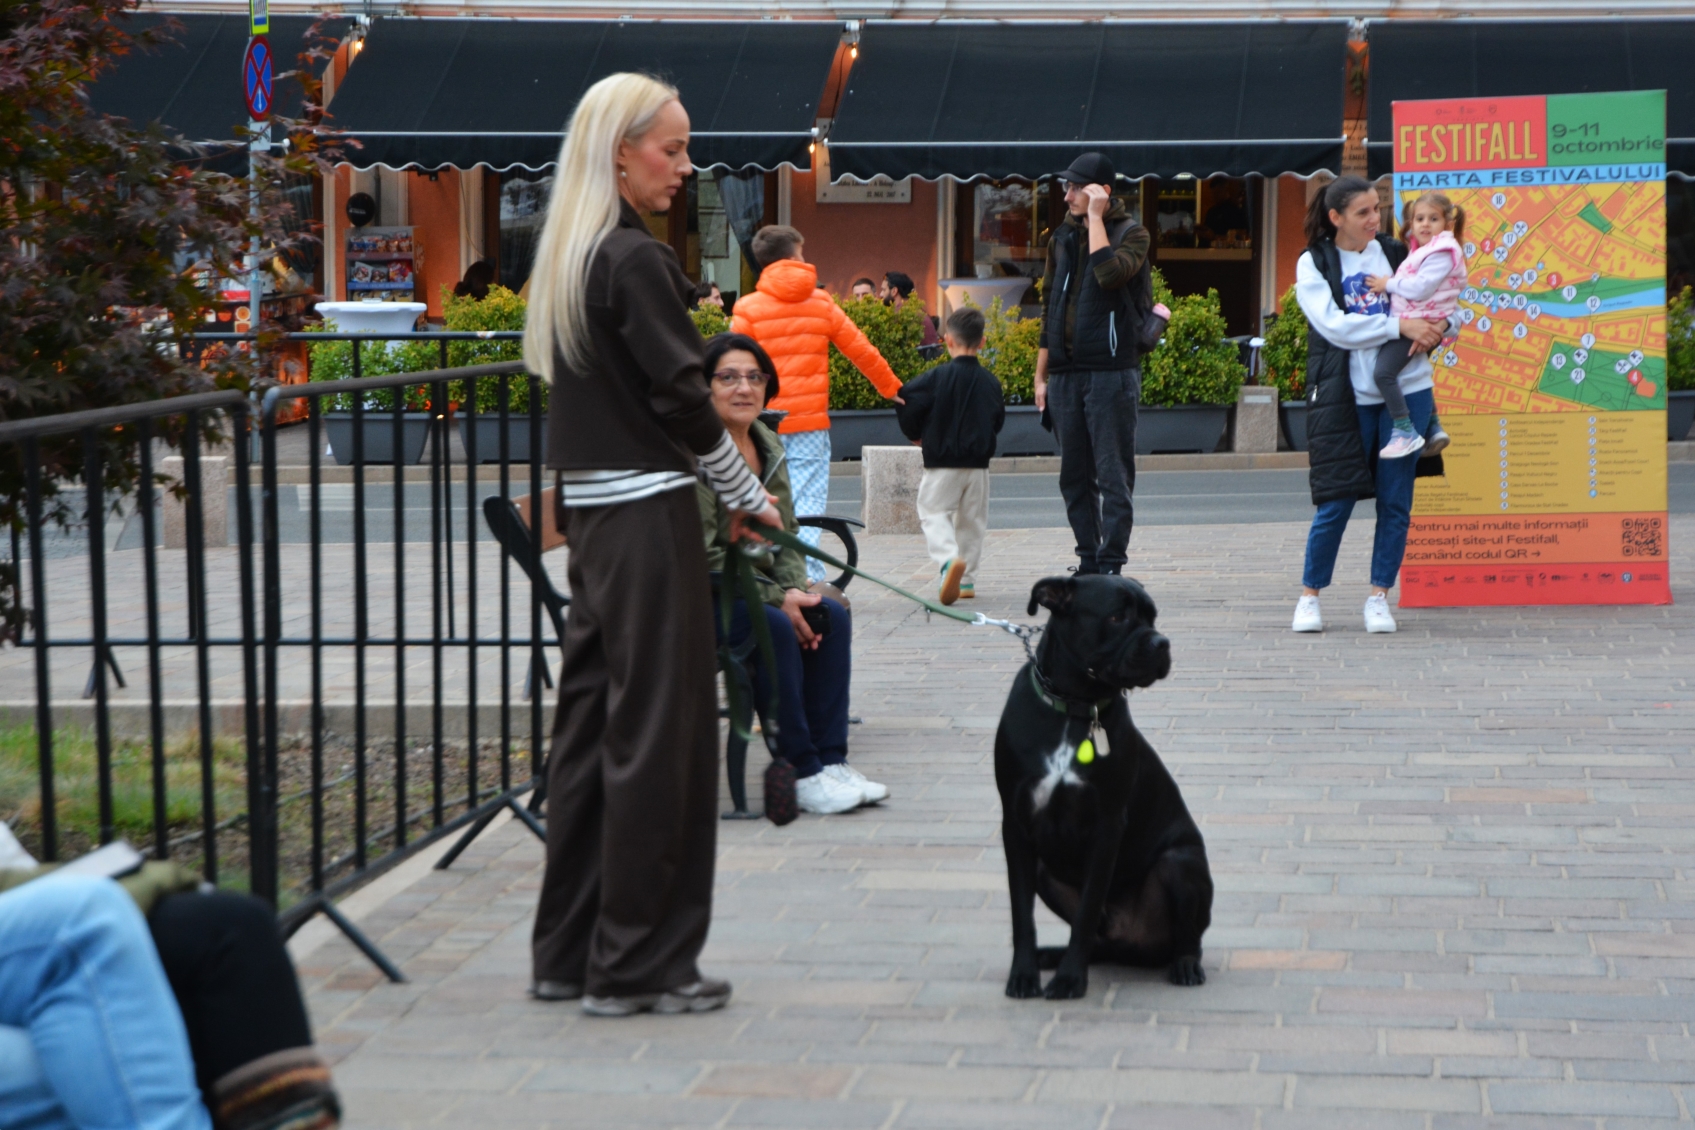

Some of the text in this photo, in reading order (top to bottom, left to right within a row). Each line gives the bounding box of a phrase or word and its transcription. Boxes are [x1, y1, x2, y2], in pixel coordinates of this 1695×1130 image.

[1552, 122, 1600, 138] 9-11
[1400, 120, 1538, 164] FESTIFALL
[1552, 136, 1664, 154] octombrie
[1400, 165, 1660, 187] HARTA FESTIVALULUI
[1496, 194, 1502, 204] 18
[1507, 233, 1514, 244] 17
[1466, 245, 1473, 254] 19
[1485, 240, 1490, 252] 2
[1551, 274, 1556, 285] 3
[1468, 290, 1476, 300] 20
[1567, 288, 1573, 297] 11
[1344, 291, 1389, 308] NASA
[1517, 297, 1524, 306] 10
[1590, 298, 1597, 308] 12
[1464, 311, 1471, 320] 15
[1531, 306, 1537, 315] 14
[1482, 320, 1486, 329] 6
[1518, 326, 1522, 336] 9
[1587, 335, 1590, 345] 7
[1556, 356, 1562, 365] 13
[1575, 370, 1582, 380] 21
[1634, 372, 1638, 381] 4
[1408, 519, 1589, 532] Pentru mai multe informații
[1406, 534, 1560, 548] accesați site-ul Festifall,
[1406, 549, 1527, 560] scanând codul QR
